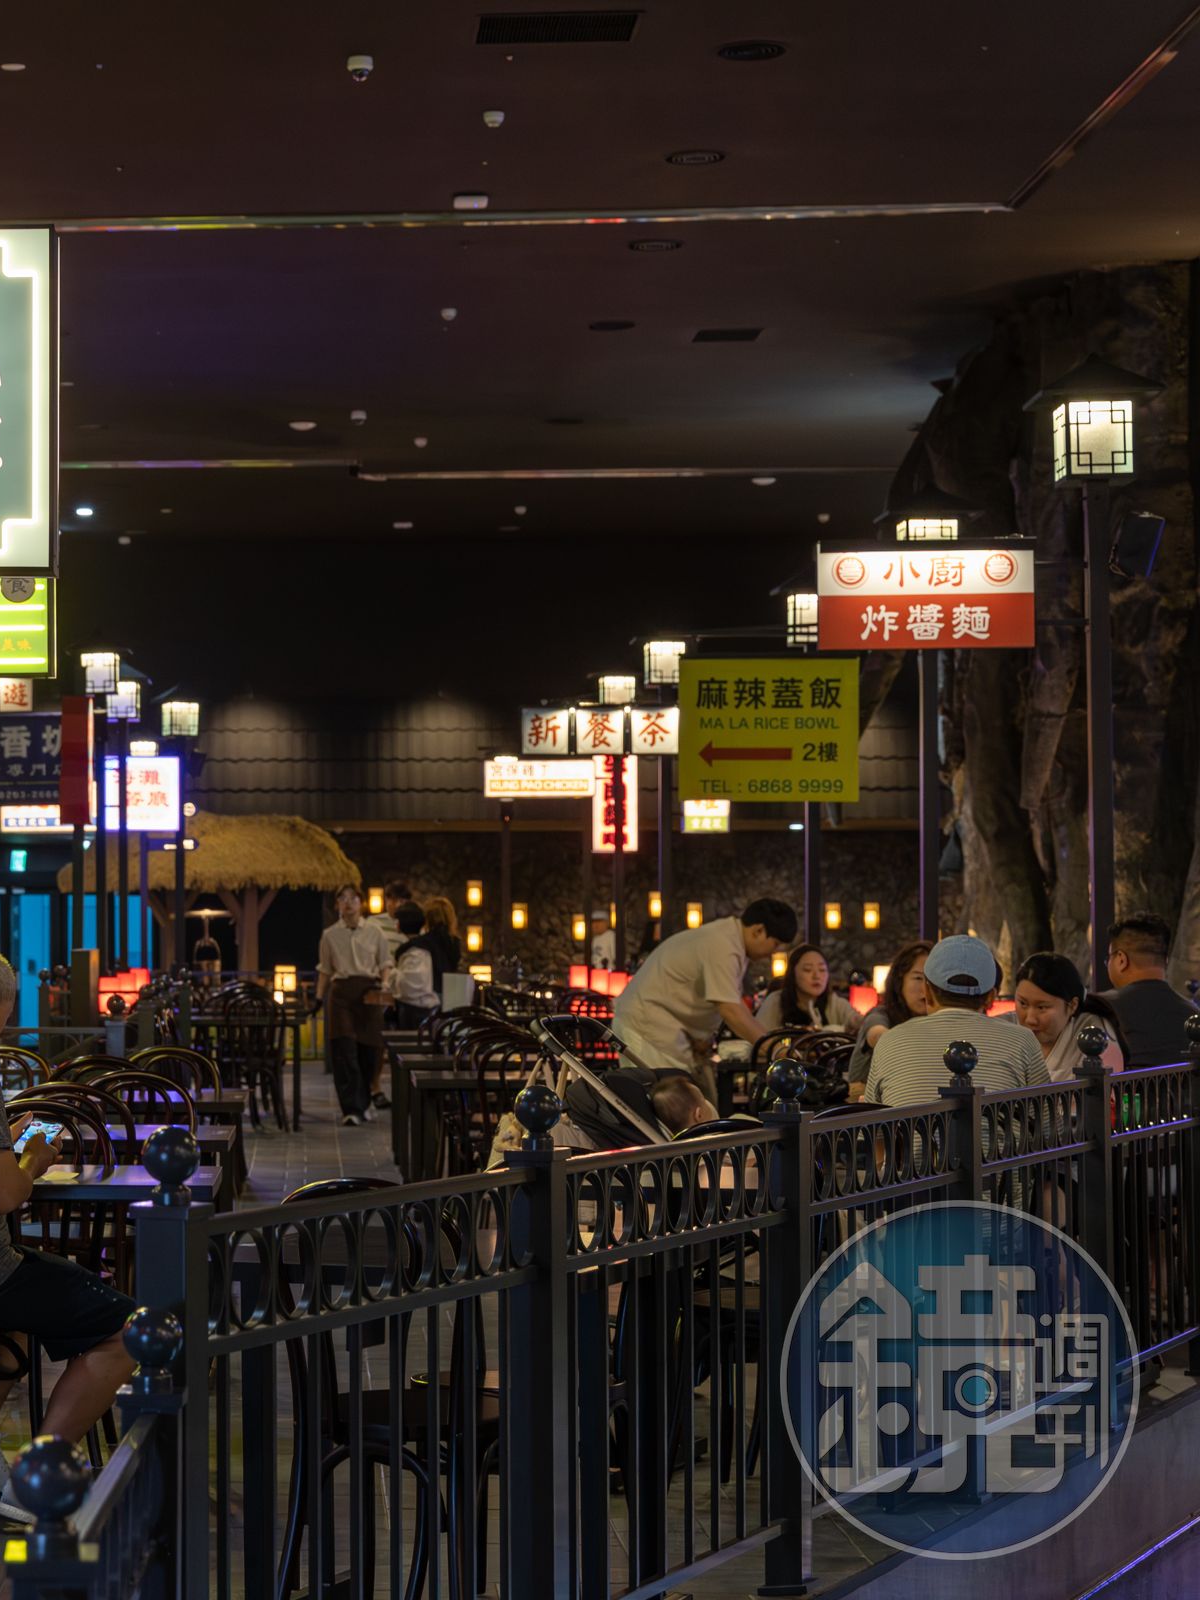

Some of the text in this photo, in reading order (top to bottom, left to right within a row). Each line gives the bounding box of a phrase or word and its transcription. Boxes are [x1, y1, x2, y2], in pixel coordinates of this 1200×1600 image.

[883, 555, 965, 588] 小廚
[860, 602, 991, 641] 炸醬麵
[695, 677, 842, 710] 麻辣蓋飯
[700, 717, 840, 729] MA LA RICE BOWL
[802, 742, 839, 762] 2樓
[748, 779, 792, 794] 6868
[798, 779, 844, 794] 9999
